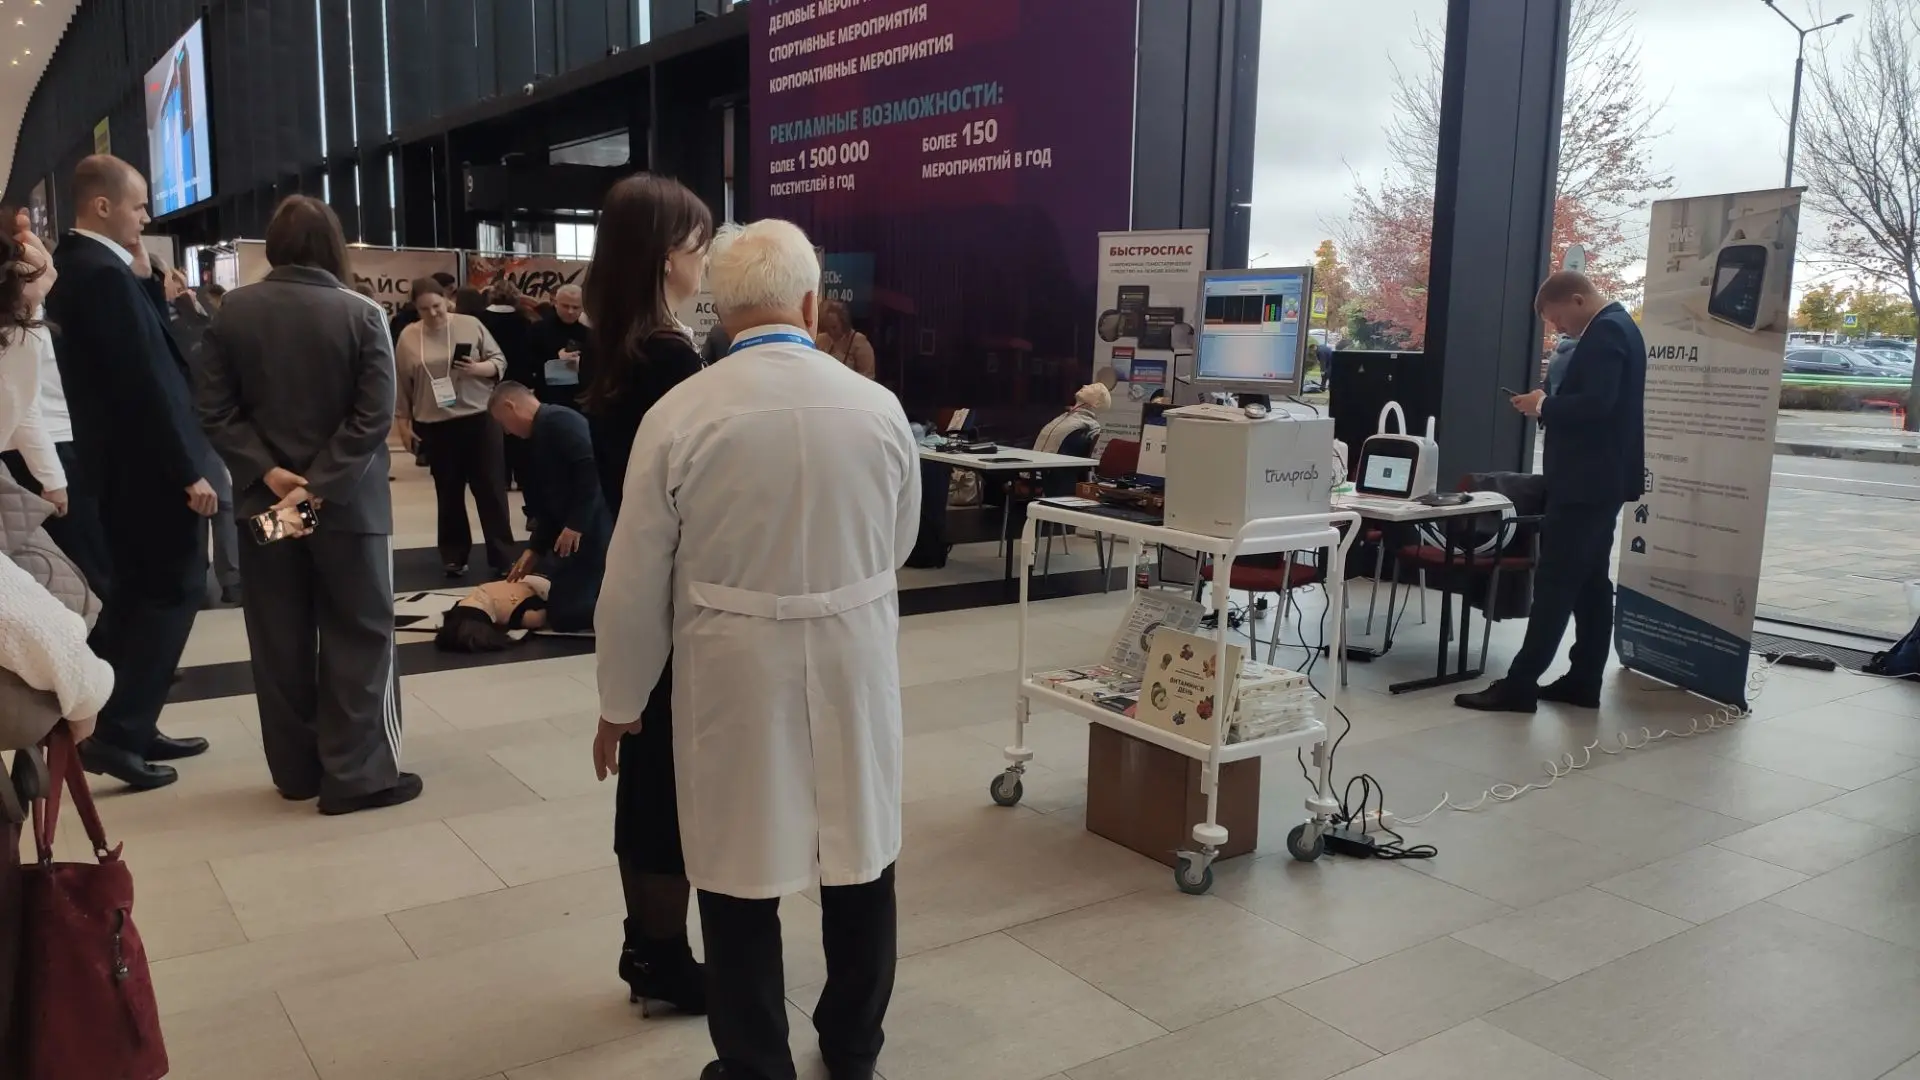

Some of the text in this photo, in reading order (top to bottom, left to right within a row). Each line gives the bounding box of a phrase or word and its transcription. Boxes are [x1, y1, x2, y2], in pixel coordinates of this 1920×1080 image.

[769, 3, 815, 36] ДЕЛОВЫЕ
[769, 3, 928, 63] СПОРТИВНЫЕ МЕРОПРИЯТИЯ
[769, 33, 954, 94] КОРПОРАТИВНЫЕ МЕРОПРИЯТИЯ
[770, 81, 1003, 145] РЕКЛАМНЫЕ ВОЗМОЖНОСТИ:
[922, 118, 998, 153] БОЛЕЕ 150
[770, 140, 869, 174] БОЛЕЕ 1 500 000
[922, 147, 1052, 178] МЕРОПРИЯТИЙ В ГОД
[770, 173, 855, 197] ПОСЕТИТЕЛЕЙ В ГОД
[1109, 245, 1194, 257] БЫСТРОСПАС
[1648, 345, 1698, 362] АИВЛ-Д
